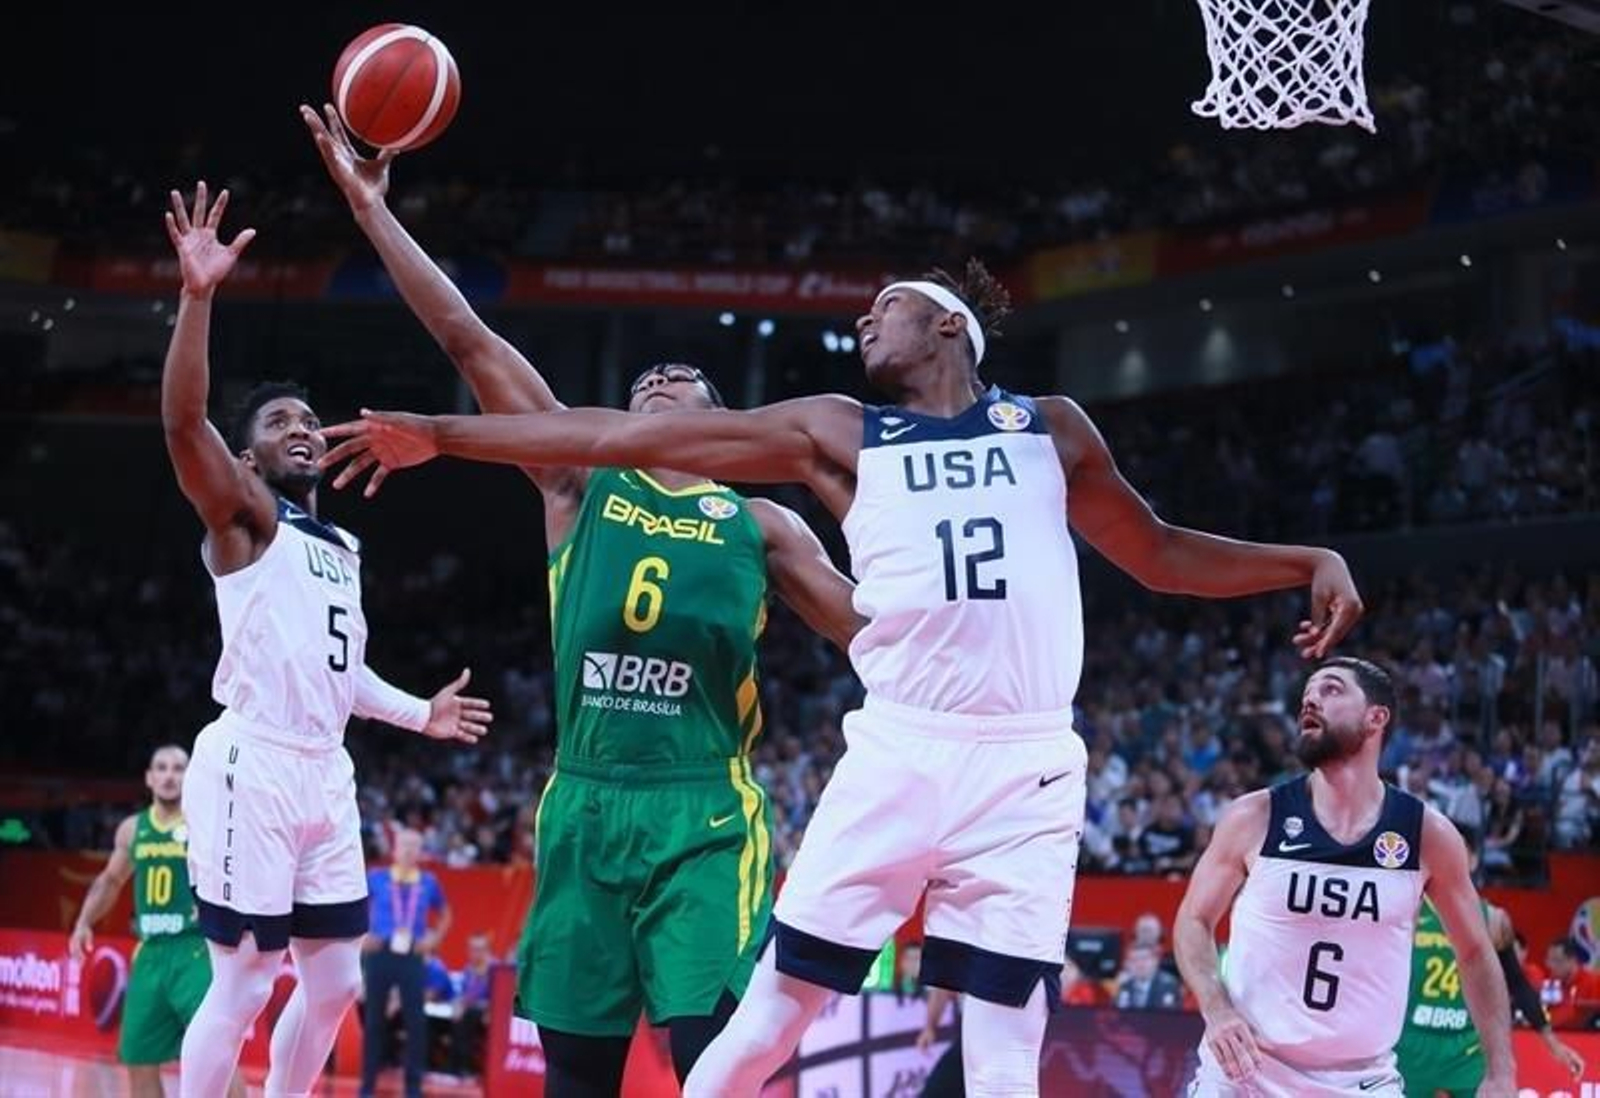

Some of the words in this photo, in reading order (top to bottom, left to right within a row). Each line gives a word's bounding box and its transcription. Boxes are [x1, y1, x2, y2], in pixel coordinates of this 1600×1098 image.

[904, 446, 1017, 492] USA
[602, 494, 725, 545] BRASIL
[304, 541, 357, 592] USA
[935, 517, 1007, 602] 12
[623, 557, 670, 633] 6
[328, 605, 348, 672] 5
[615, 655, 693, 698] BRB
[614, 697, 632, 711] DE
[223, 744, 240, 902] UNITED
[146, 865, 173, 906] 10
[1286, 872, 1381, 922] USA
[1303, 941, 1344, 1012] 6
[1422, 956, 1460, 1001] 24
